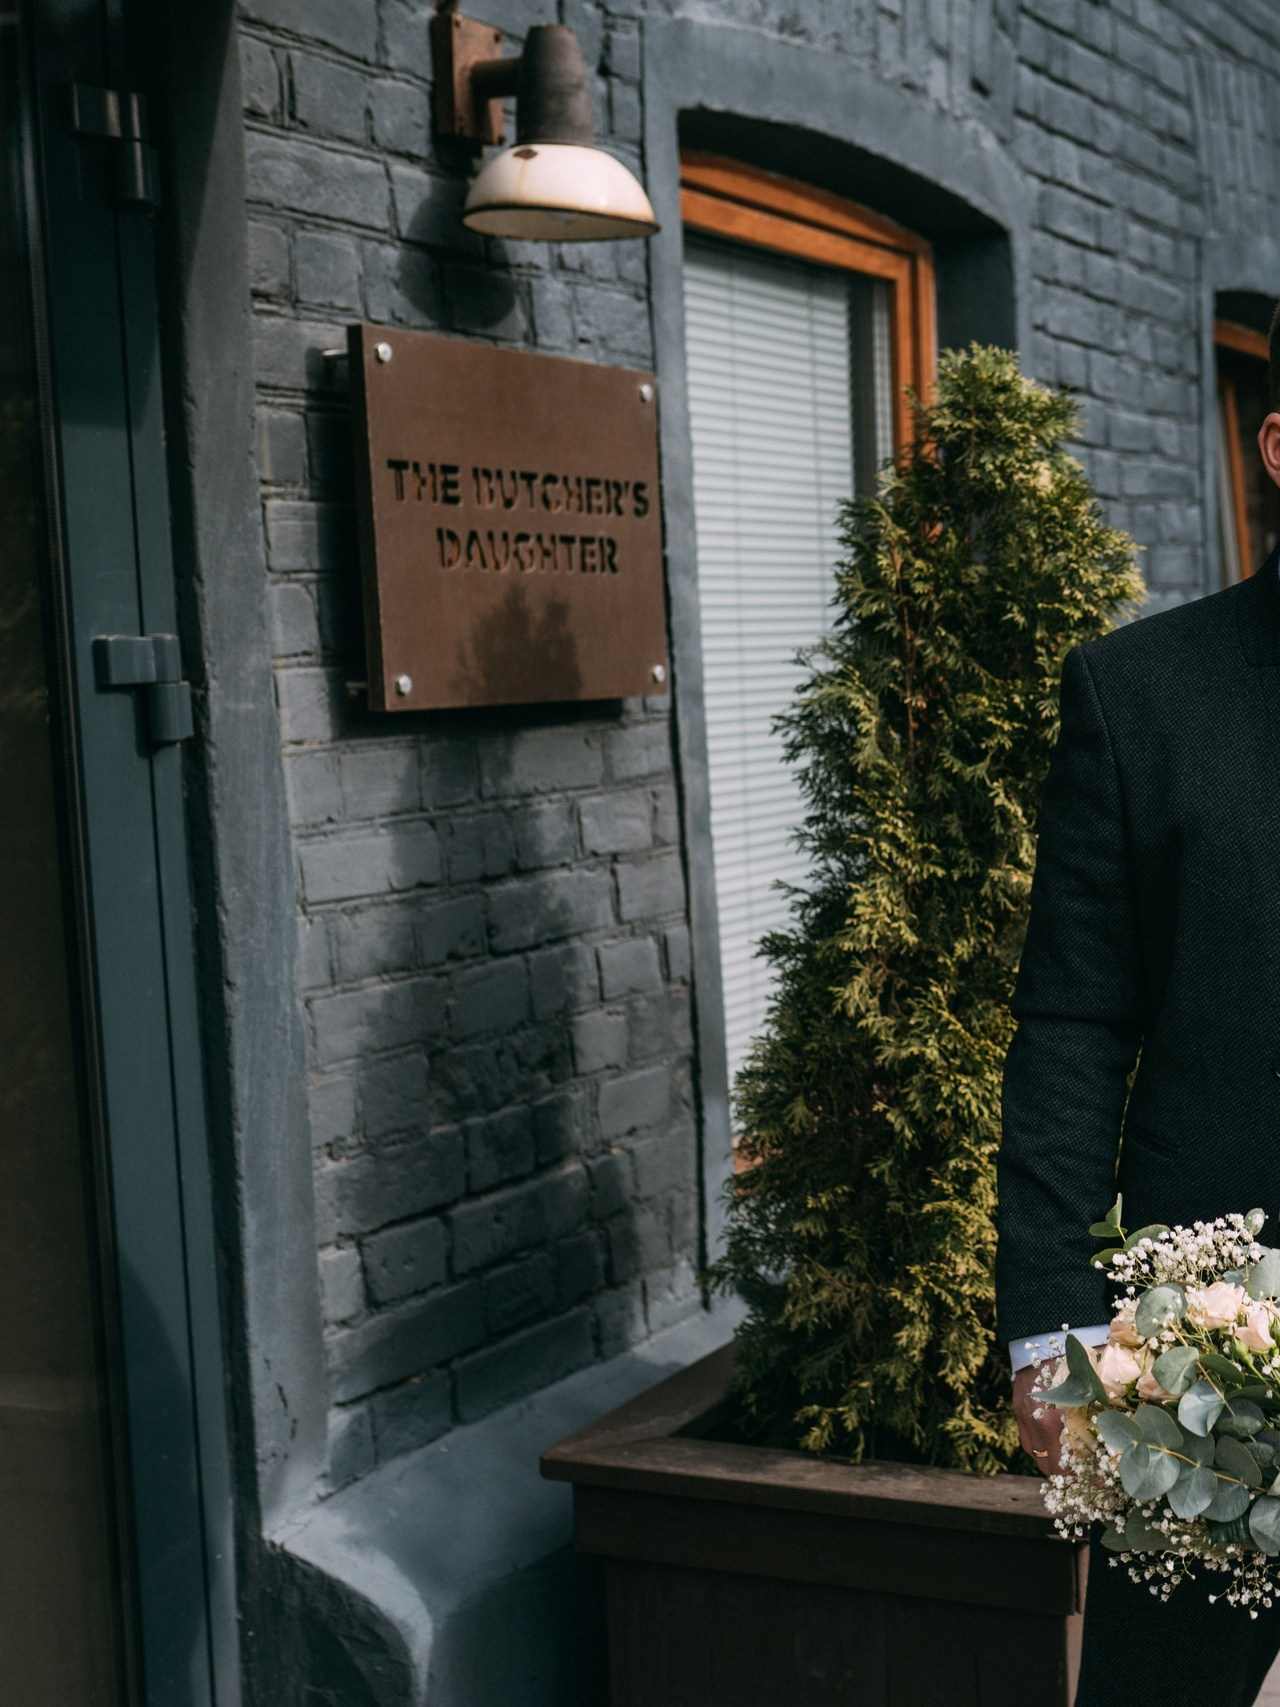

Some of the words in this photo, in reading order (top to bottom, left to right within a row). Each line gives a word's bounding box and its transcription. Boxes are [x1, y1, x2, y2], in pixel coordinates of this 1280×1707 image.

[387, 459, 461, 505] THE
[472, 466, 650, 518] BUTCHER'S
[436, 527, 619, 574] DAUGHTER
